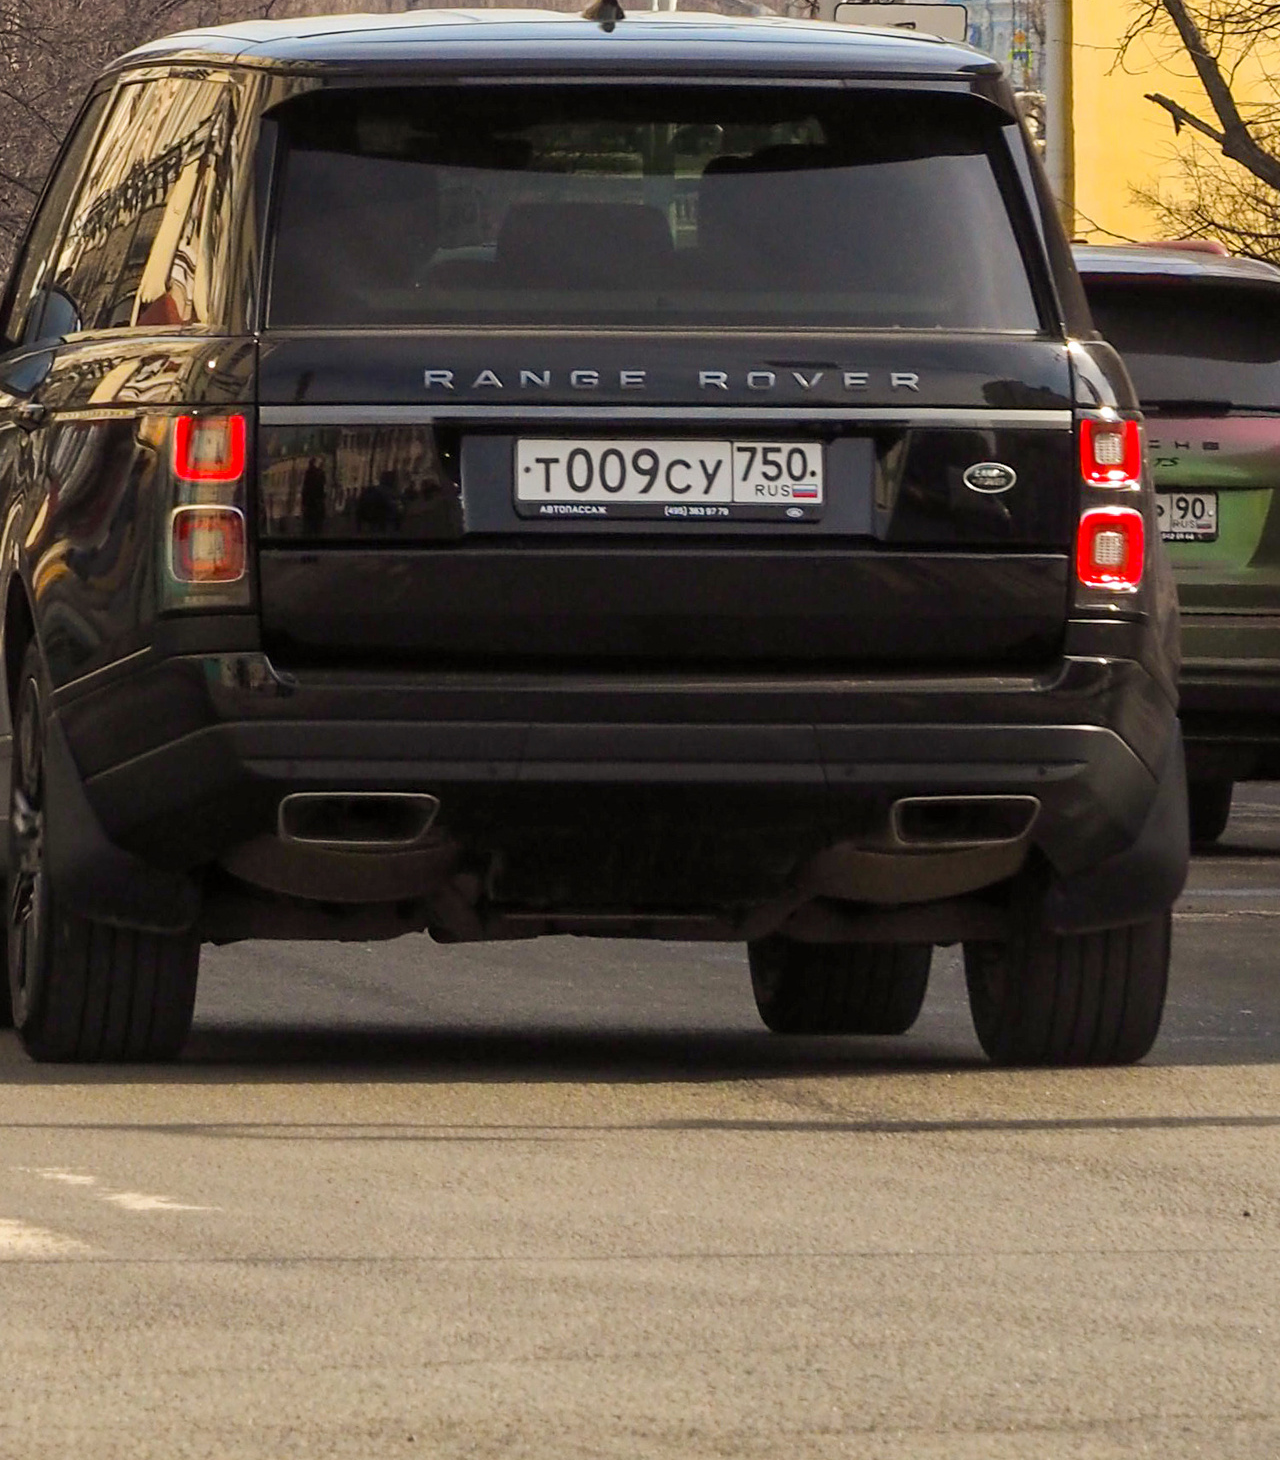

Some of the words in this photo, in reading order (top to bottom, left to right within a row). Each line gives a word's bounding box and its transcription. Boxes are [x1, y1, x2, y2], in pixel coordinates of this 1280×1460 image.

[423, 369, 647, 390] RANGE
[698, 371, 920, 392] ROVER
[736, 446, 809, 482] 750
[754, 484, 791, 497] RUS
[1175, 496, 1206, 520] 90
